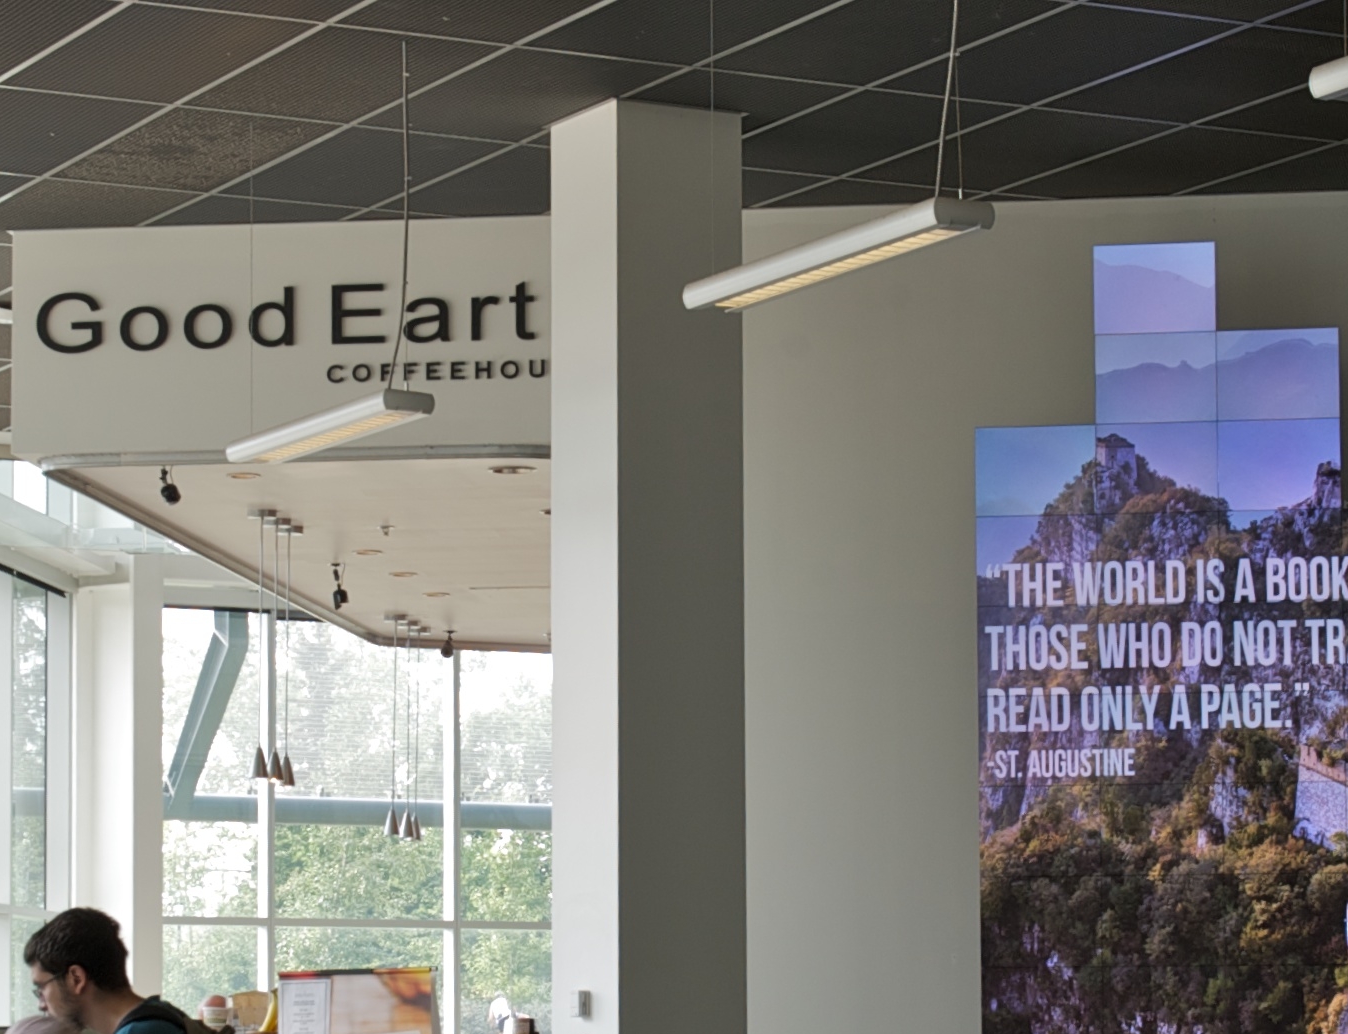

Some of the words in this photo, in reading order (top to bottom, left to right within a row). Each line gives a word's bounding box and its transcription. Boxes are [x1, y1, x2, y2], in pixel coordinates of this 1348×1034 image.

[36, 286, 294, 354] Good
[331, 281, 537, 345] Eart
[326, 359, 547, 383] COFFEEHOU
[985, 562, 1064, 608] “THE
[1072, 559, 1187, 607] WORLD
[1196, 558, 1225, 604] IS
[1234, 558, 1256, 603] A
[984, 623, 1089, 671] THOSE
[1098, 621, 1172, 669] WHO
[1181, 620, 1224, 667] DO
[1233, 619, 1297, 667] NOT
[986, 687, 1071, 733] READ
[1080, 685, 1161, 731] ONLY
[1169, 684, 1191, 730] A
[1201, 682, 1310, 730] PAGE.”
[987, 750, 1023, 778] -ST.
[1028, 748, 1136, 778] AUGUSTINE
